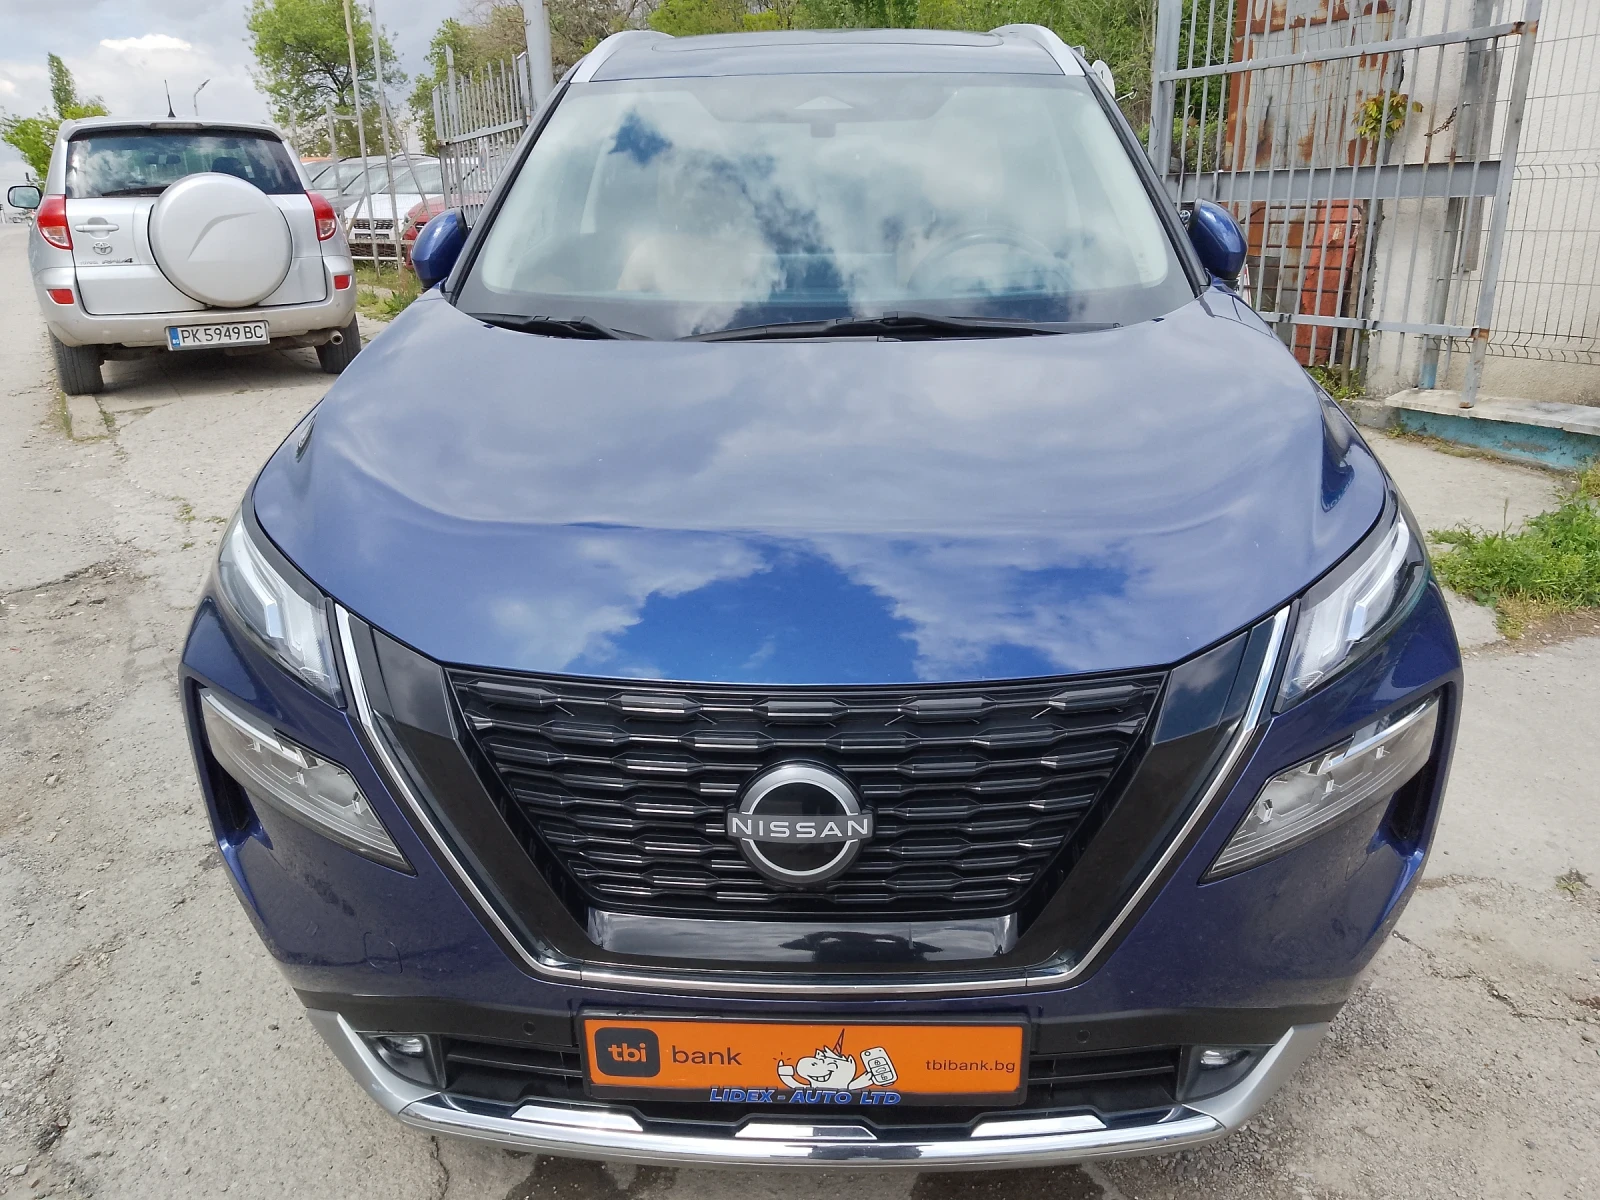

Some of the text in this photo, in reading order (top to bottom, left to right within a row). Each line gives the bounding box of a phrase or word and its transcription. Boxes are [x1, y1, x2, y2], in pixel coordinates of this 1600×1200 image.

[181, 325, 264, 343] PK 5949 BC
[732, 817, 868, 838] NISSAN
[608, 1042, 743, 1065] tbi bank
[925, 1059, 1016, 1073] tbibank.bg
[709, 1087, 773, 1103] LIDEX
[788, 1089, 852, 1105] AUTO
[859, 1090, 901, 1105] LTD
